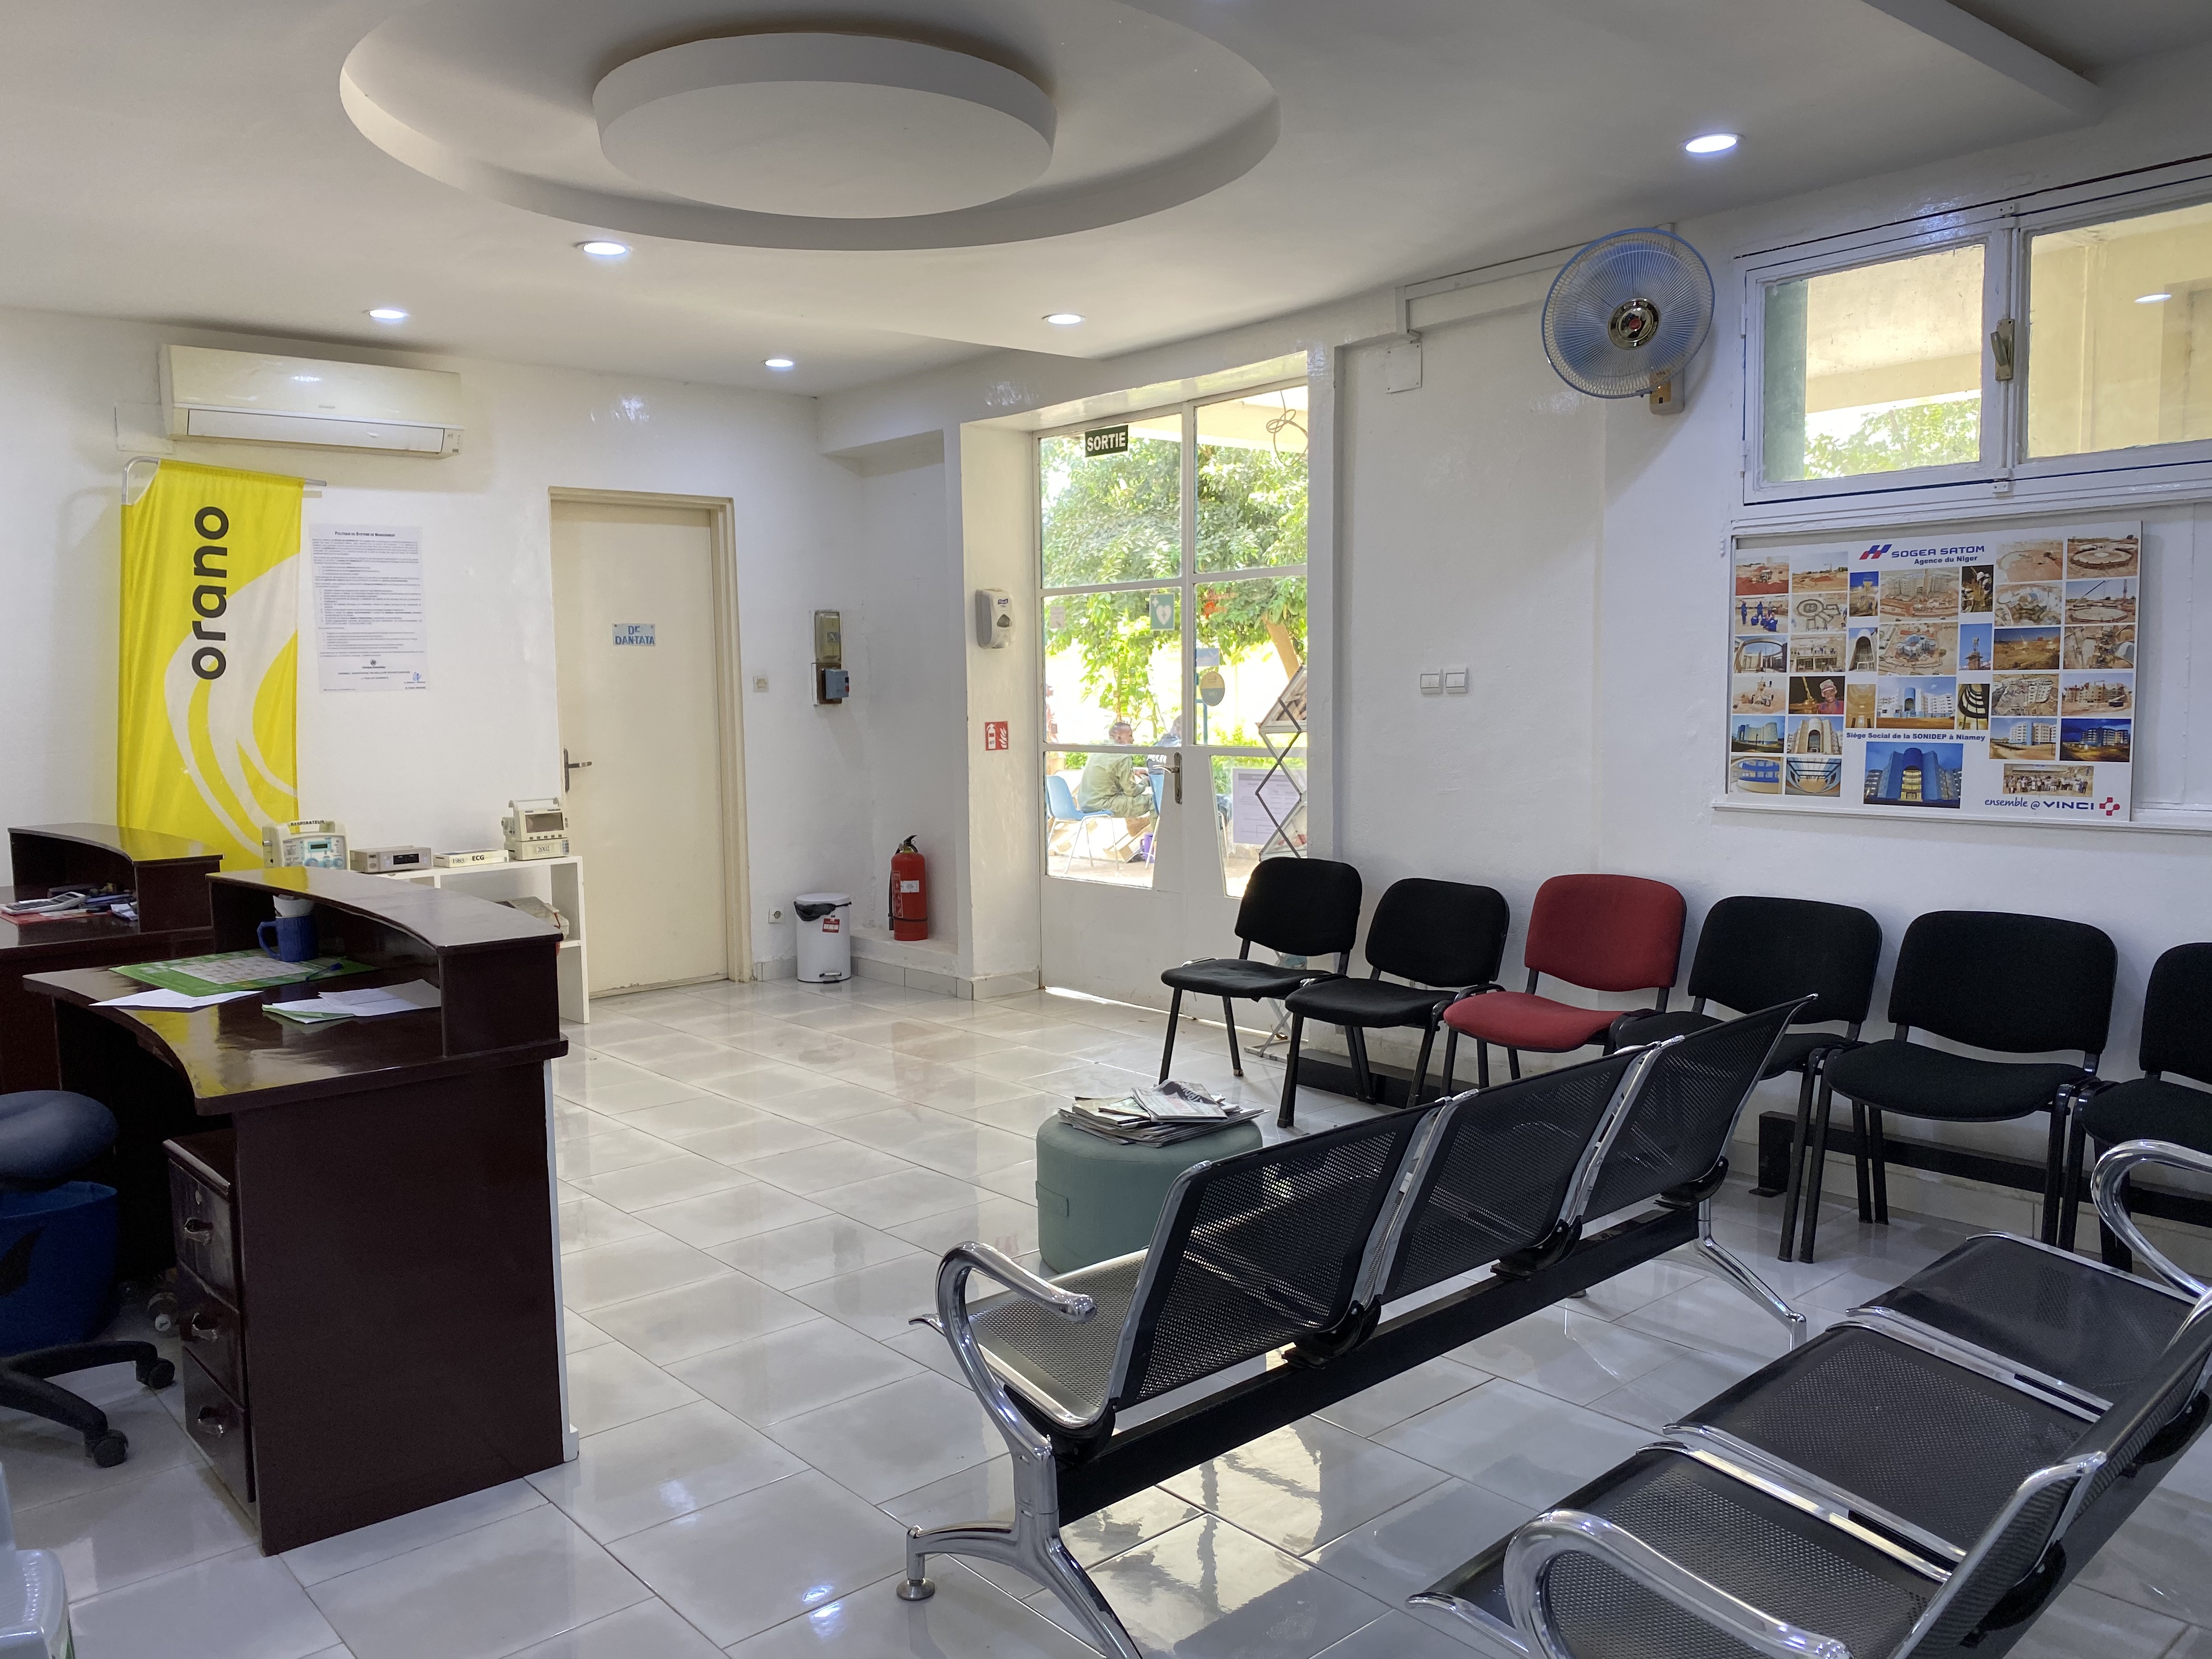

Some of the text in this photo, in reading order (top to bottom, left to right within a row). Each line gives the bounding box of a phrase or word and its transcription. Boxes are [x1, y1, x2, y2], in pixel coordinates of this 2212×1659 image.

[1087, 432, 1126, 452] SORTIE
[1892, 545, 1985, 558] SOGEA SATOM
[191, 506, 229, 680] orano
[1985, 797, 2094, 810] ensemble @ VINCI
